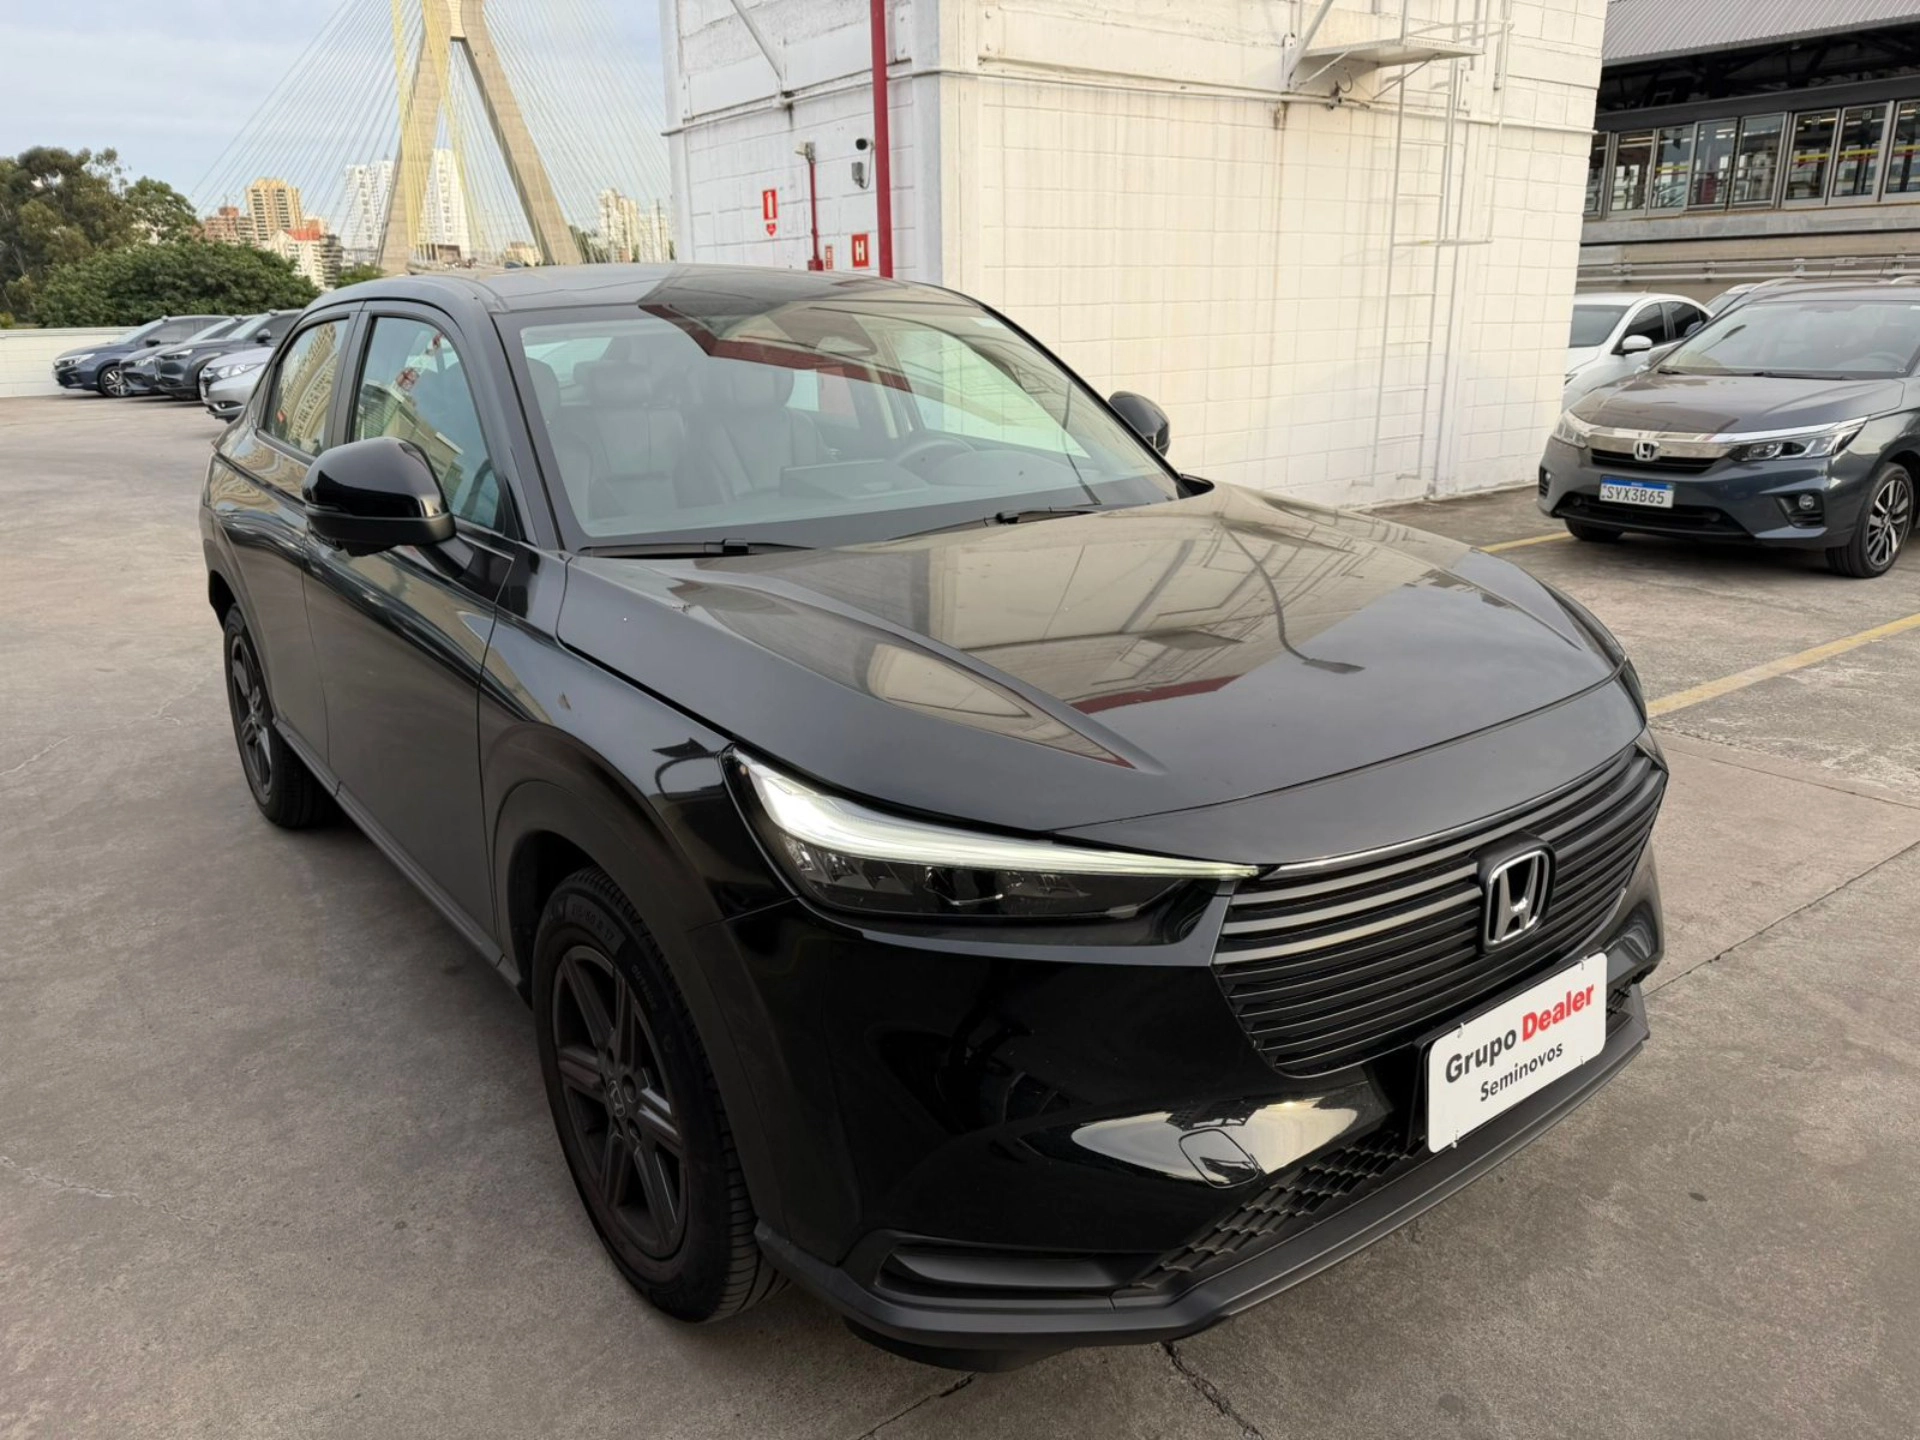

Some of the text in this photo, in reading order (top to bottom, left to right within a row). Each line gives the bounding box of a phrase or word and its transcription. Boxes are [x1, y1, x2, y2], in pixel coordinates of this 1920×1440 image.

[855, 240, 865, 261] H
[1606, 486, 1665, 504] SYX3B65
[1445, 984, 1594, 1083] Grupo Dealer
[1480, 1043, 1563, 1102] Seminovos
